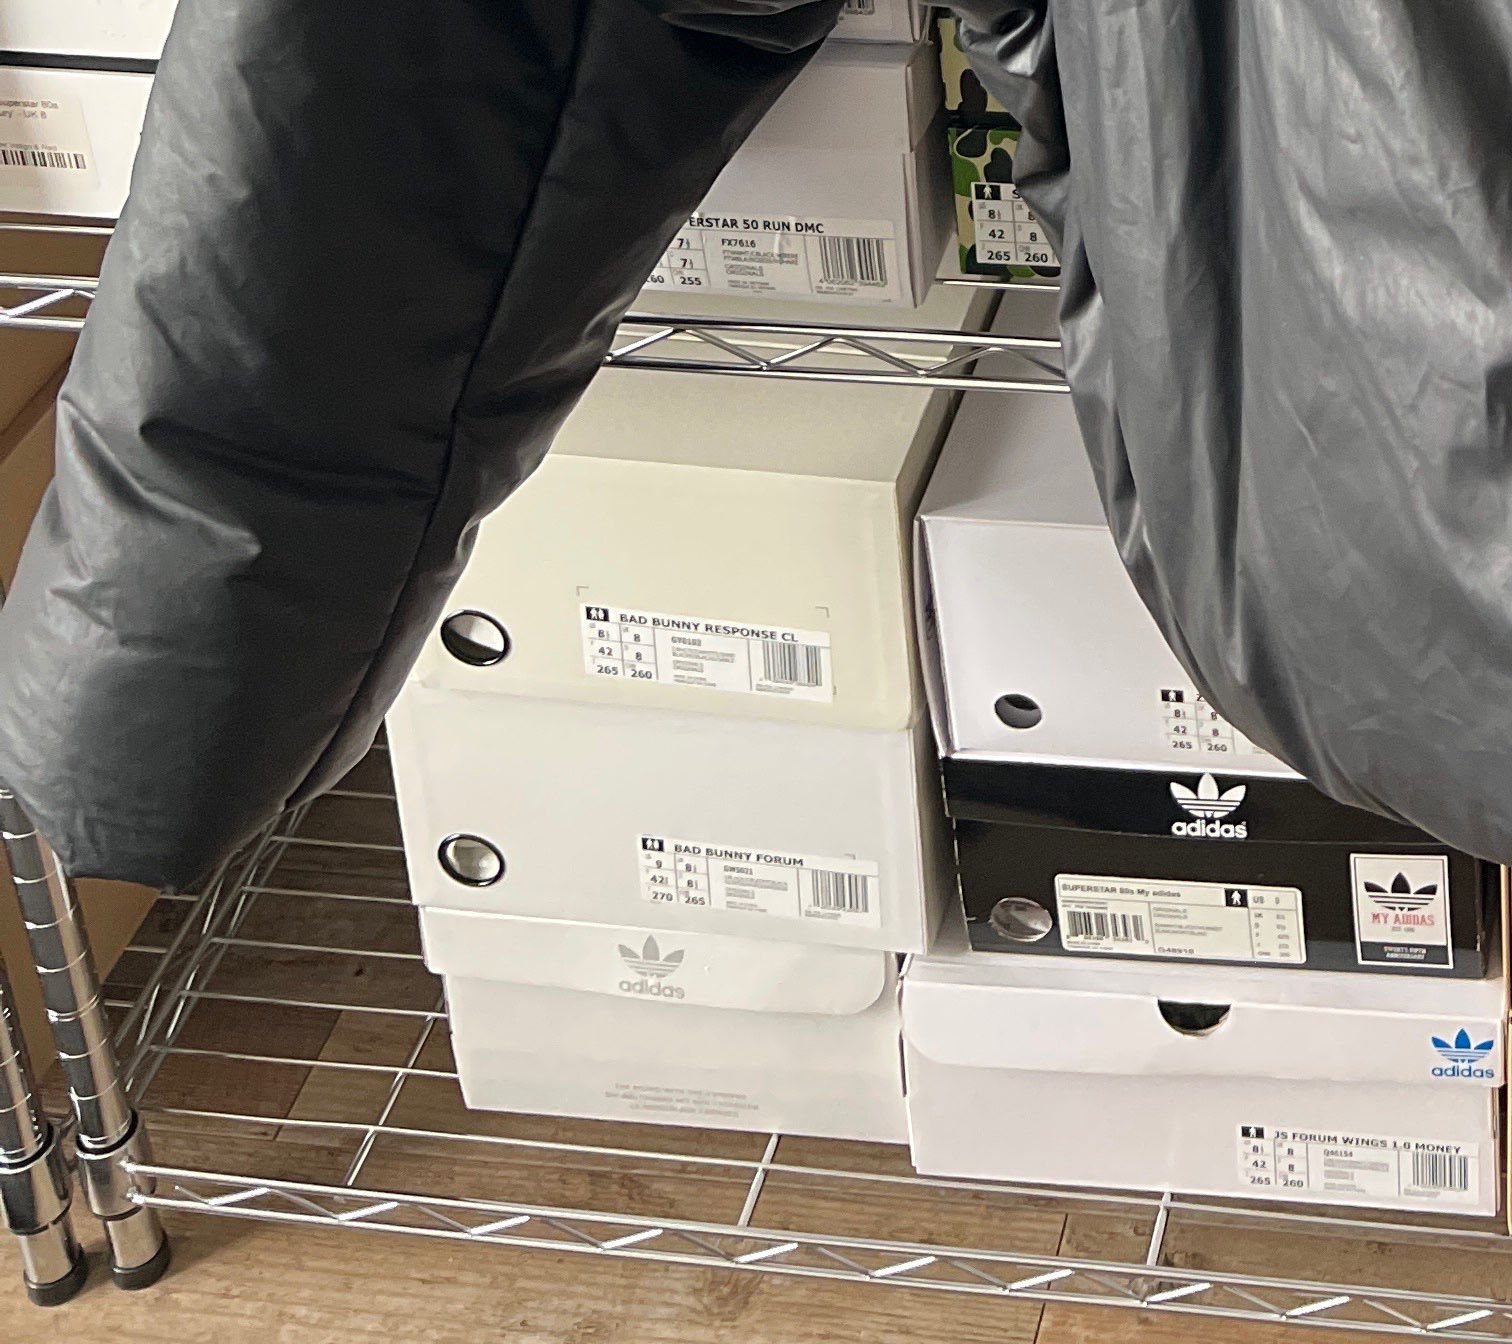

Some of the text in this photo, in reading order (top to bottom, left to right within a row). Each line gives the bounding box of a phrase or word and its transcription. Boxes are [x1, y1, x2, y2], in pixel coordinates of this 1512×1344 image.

[689, 217, 824, 234] ERSTAR 50 RUN DMC
[989, 229, 1005, 239] 42
[987, 250, 1011, 261] 265
[1025, 253, 1048, 263] 260
[680, 276, 702, 286] 255
[620, 613, 798, 642] BAD BUNNY RESPONSE CL
[599, 646, 613, 656] 42
[597, 664, 618, 676] 265
[630, 669, 652, 679] 260
[1172, 741, 1192, 749] 265
[1207, 743, 1227, 752] 260
[1171, 819, 1247, 839] adidas
[674, 843, 804, 866] BAD BUNNY FORUM
[652, 891, 673, 902] 270
[619, 978, 685, 1000] adidas
[1431, 1064, 1494, 1079] adidas
[1292, 1132, 1338, 1144] FORUM
[1342, 1137, 1388, 1148] WINGS
[1415, 1143, 1462, 1154] MONEY
